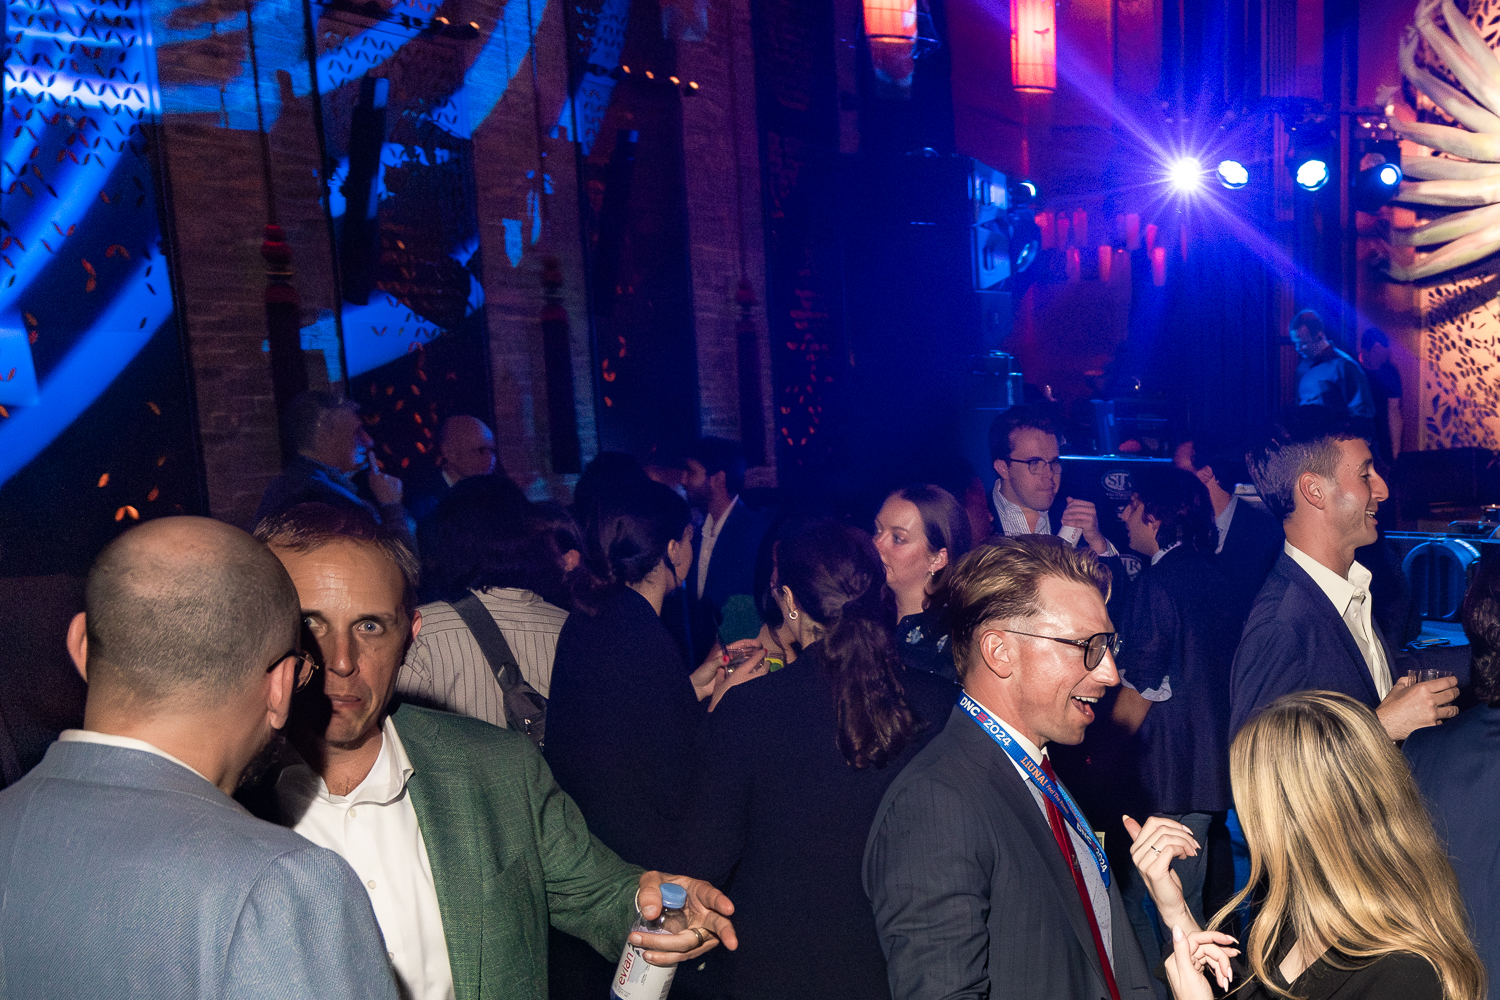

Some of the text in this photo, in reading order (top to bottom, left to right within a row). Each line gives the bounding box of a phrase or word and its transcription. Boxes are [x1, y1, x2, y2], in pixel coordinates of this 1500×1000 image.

[959, 696, 1012, 747] DNC 2024
[1019, 755, 1048, 787] LiUNA!
[1045, 784, 1056, 796] Feel
[1095, 847, 1108, 873] 2024
[618, 952, 633, 985] evian
